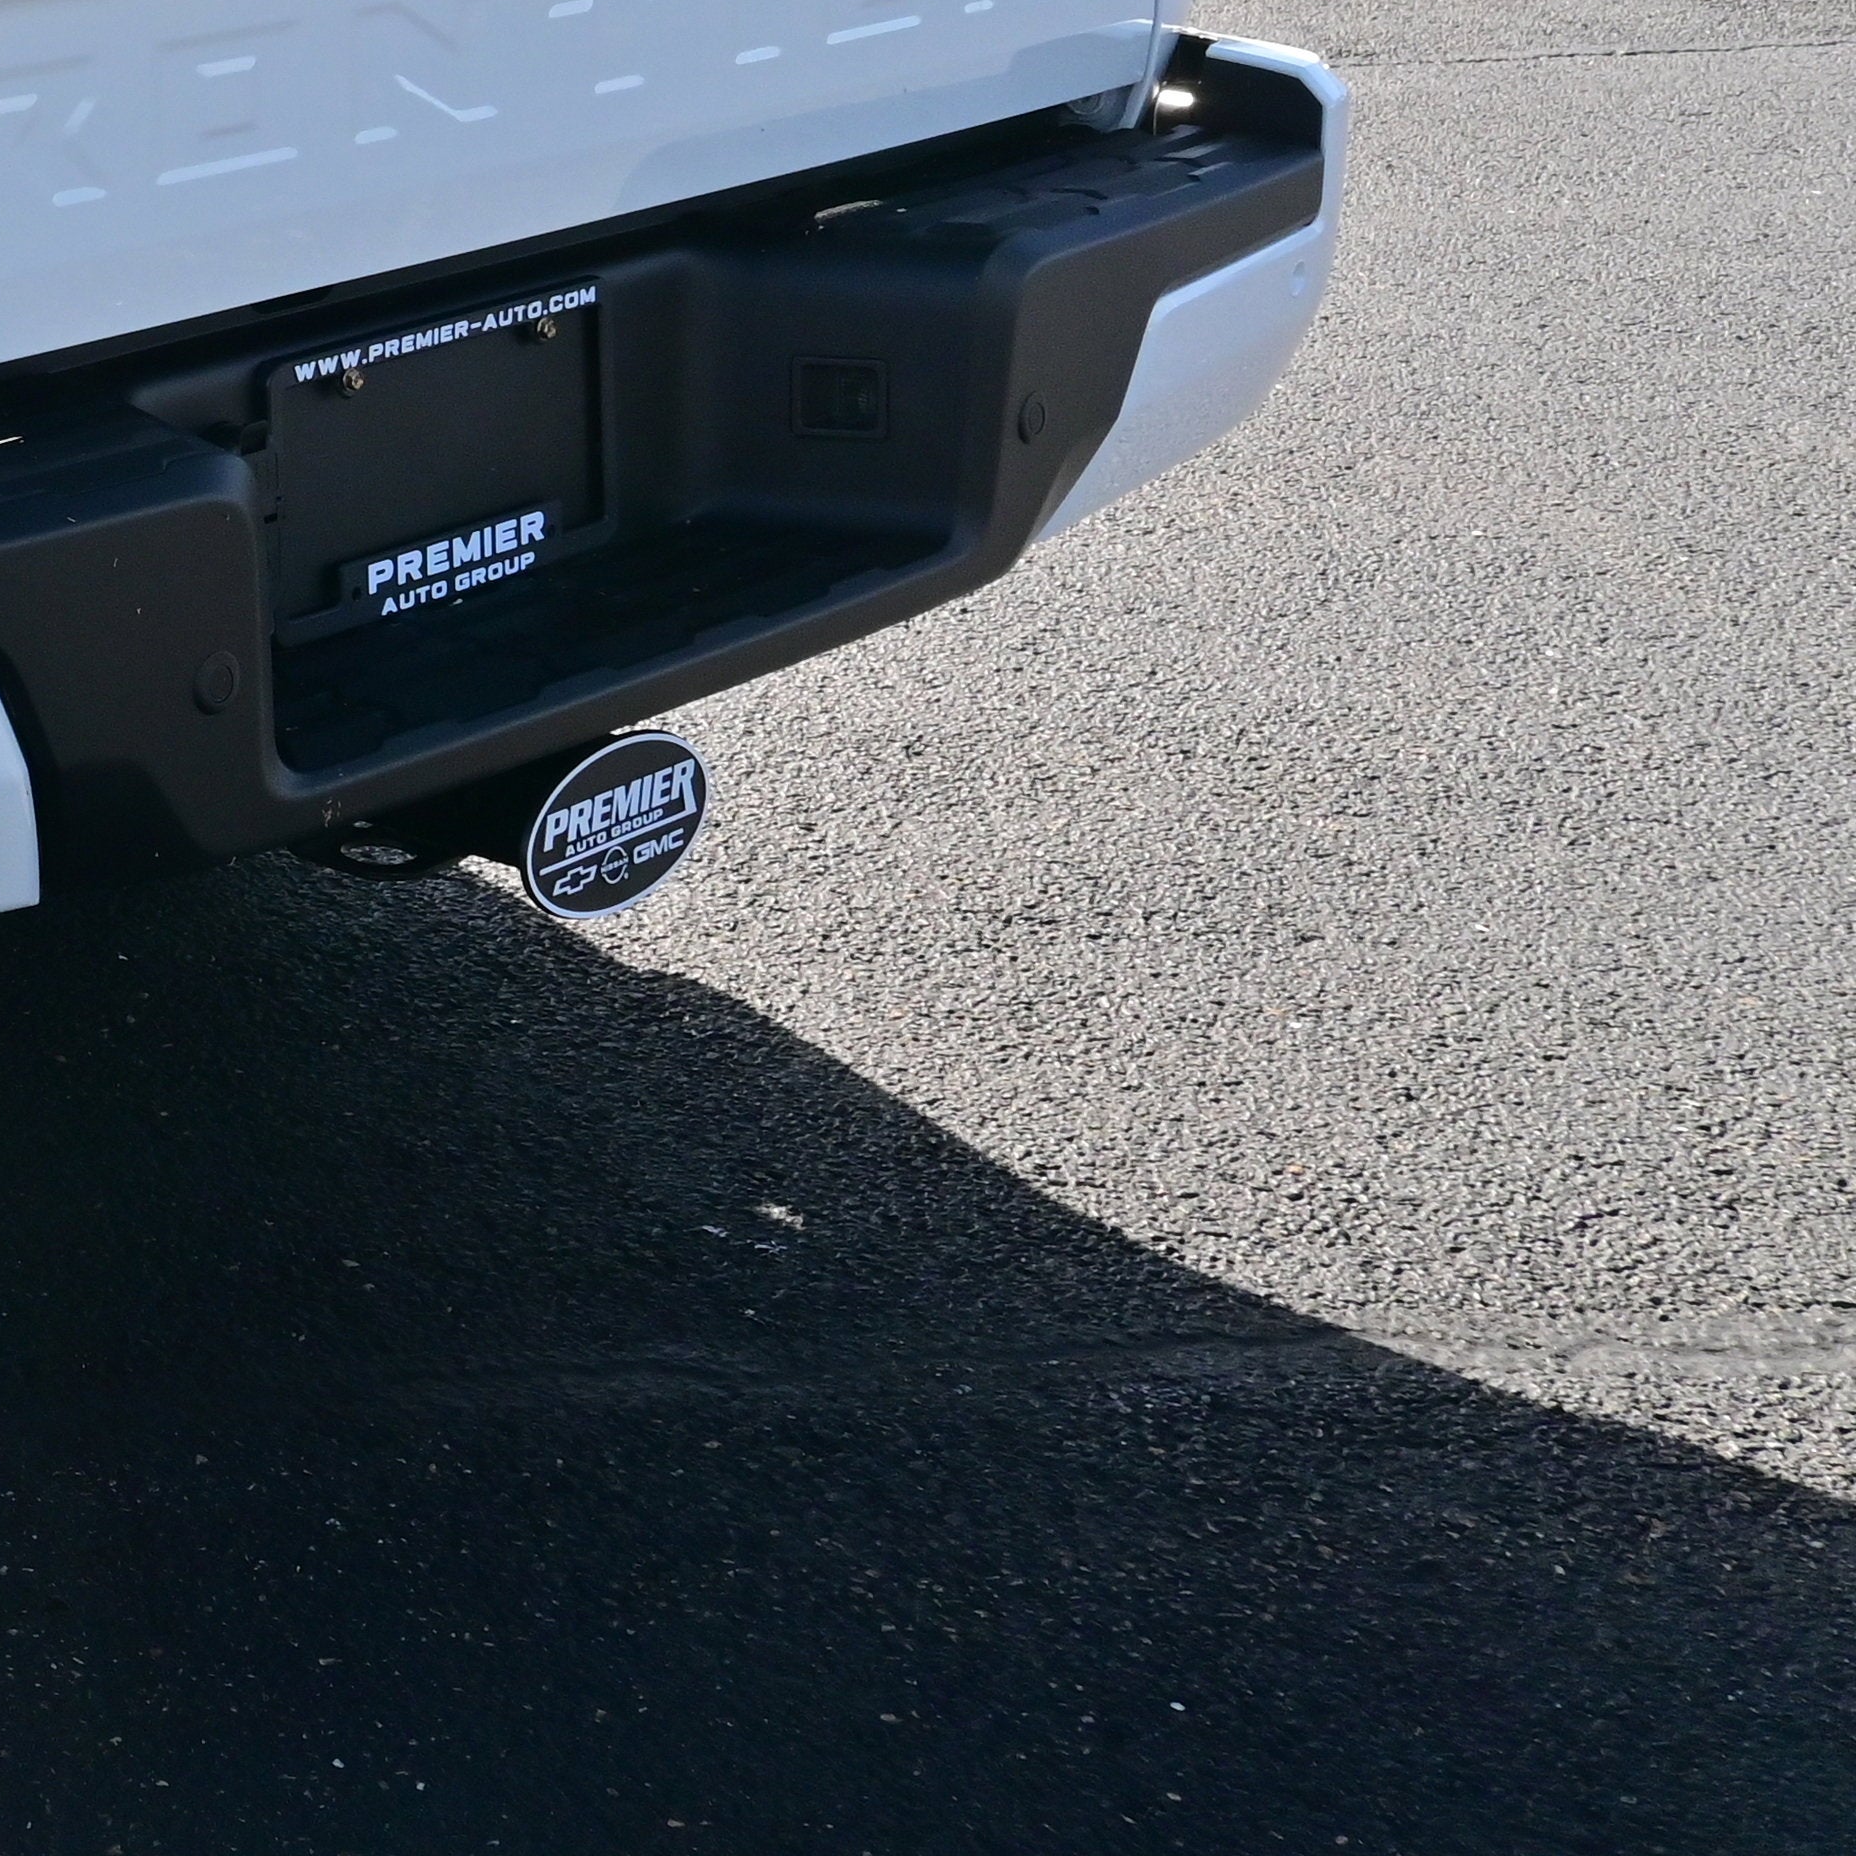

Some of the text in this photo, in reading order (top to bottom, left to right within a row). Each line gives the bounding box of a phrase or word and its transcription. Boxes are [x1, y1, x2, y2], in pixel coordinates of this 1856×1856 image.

[294, 285, 597, 384] WWW.PREMIER-AUTO.COM
[367, 510, 546, 595] PREMIER
[381, 551, 536, 616] AUTO GROUP
[543, 758, 698, 853] PREMIER
[564, 808, 664, 858] AUTO GROUP
[600, 856, 630, 874] NISSAN
[633, 828, 685, 865] GMC
